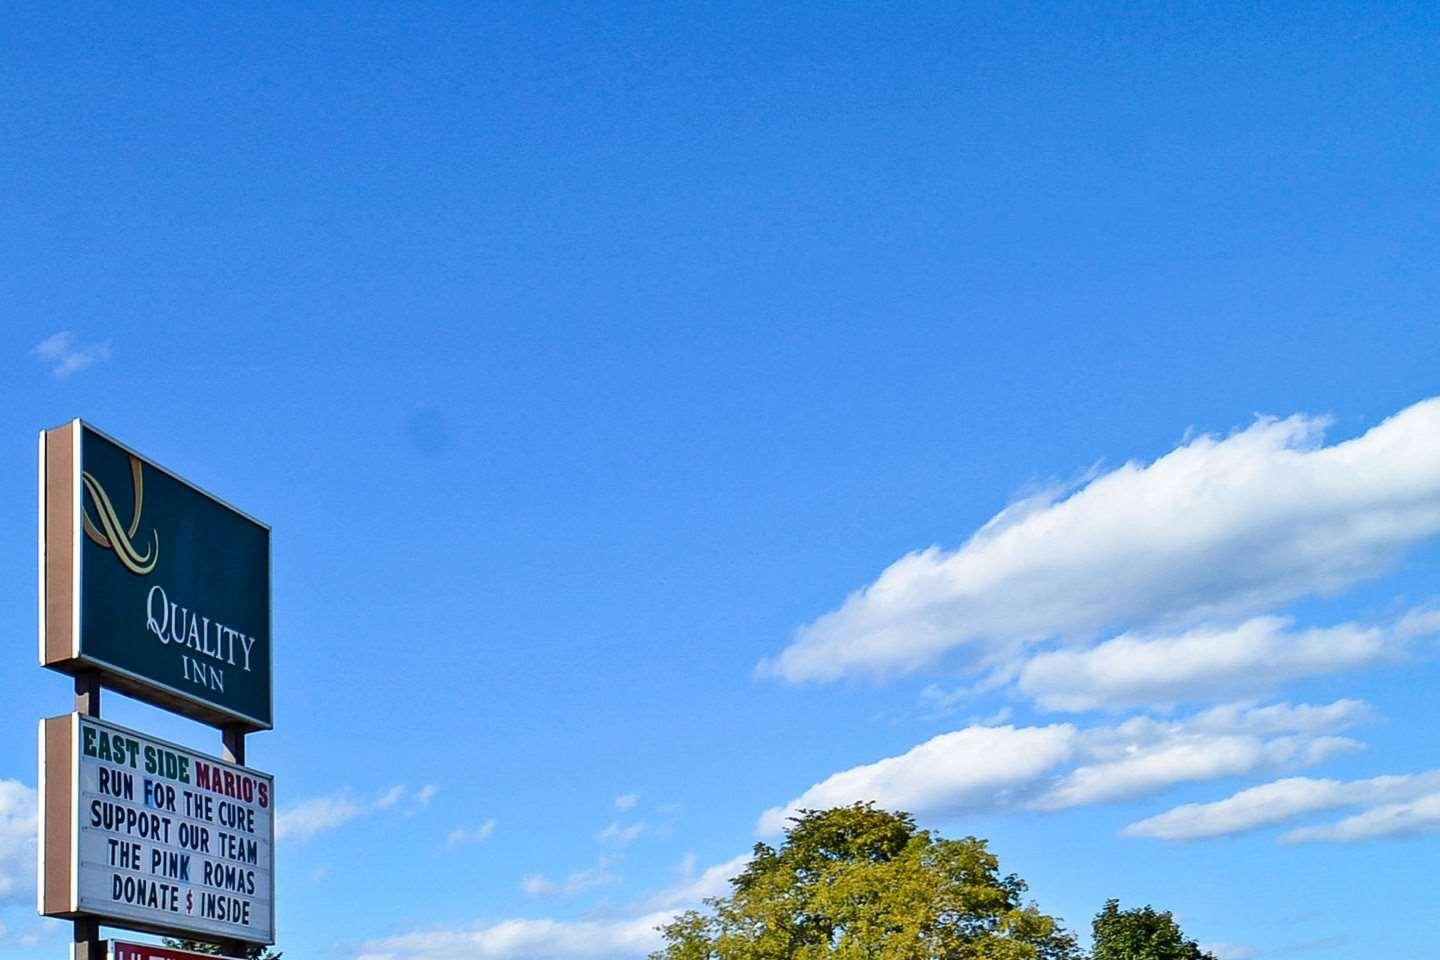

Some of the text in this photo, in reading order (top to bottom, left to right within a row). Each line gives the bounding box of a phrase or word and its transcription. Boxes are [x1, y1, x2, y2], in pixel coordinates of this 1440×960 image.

[147, 585, 255, 672] QUALITY
[182, 655, 224, 693] INN
[83, 726, 268, 808] EAST SIDE MARIO'S
[91, 800, 258, 865] SUPPORT OUR TEAM
[99, 767, 255, 833] RUN FOR THE CURE
[108, 838, 255, 895] THE PINK ROMAS
[113, 874, 250, 925] DONATE $ INSIDE
